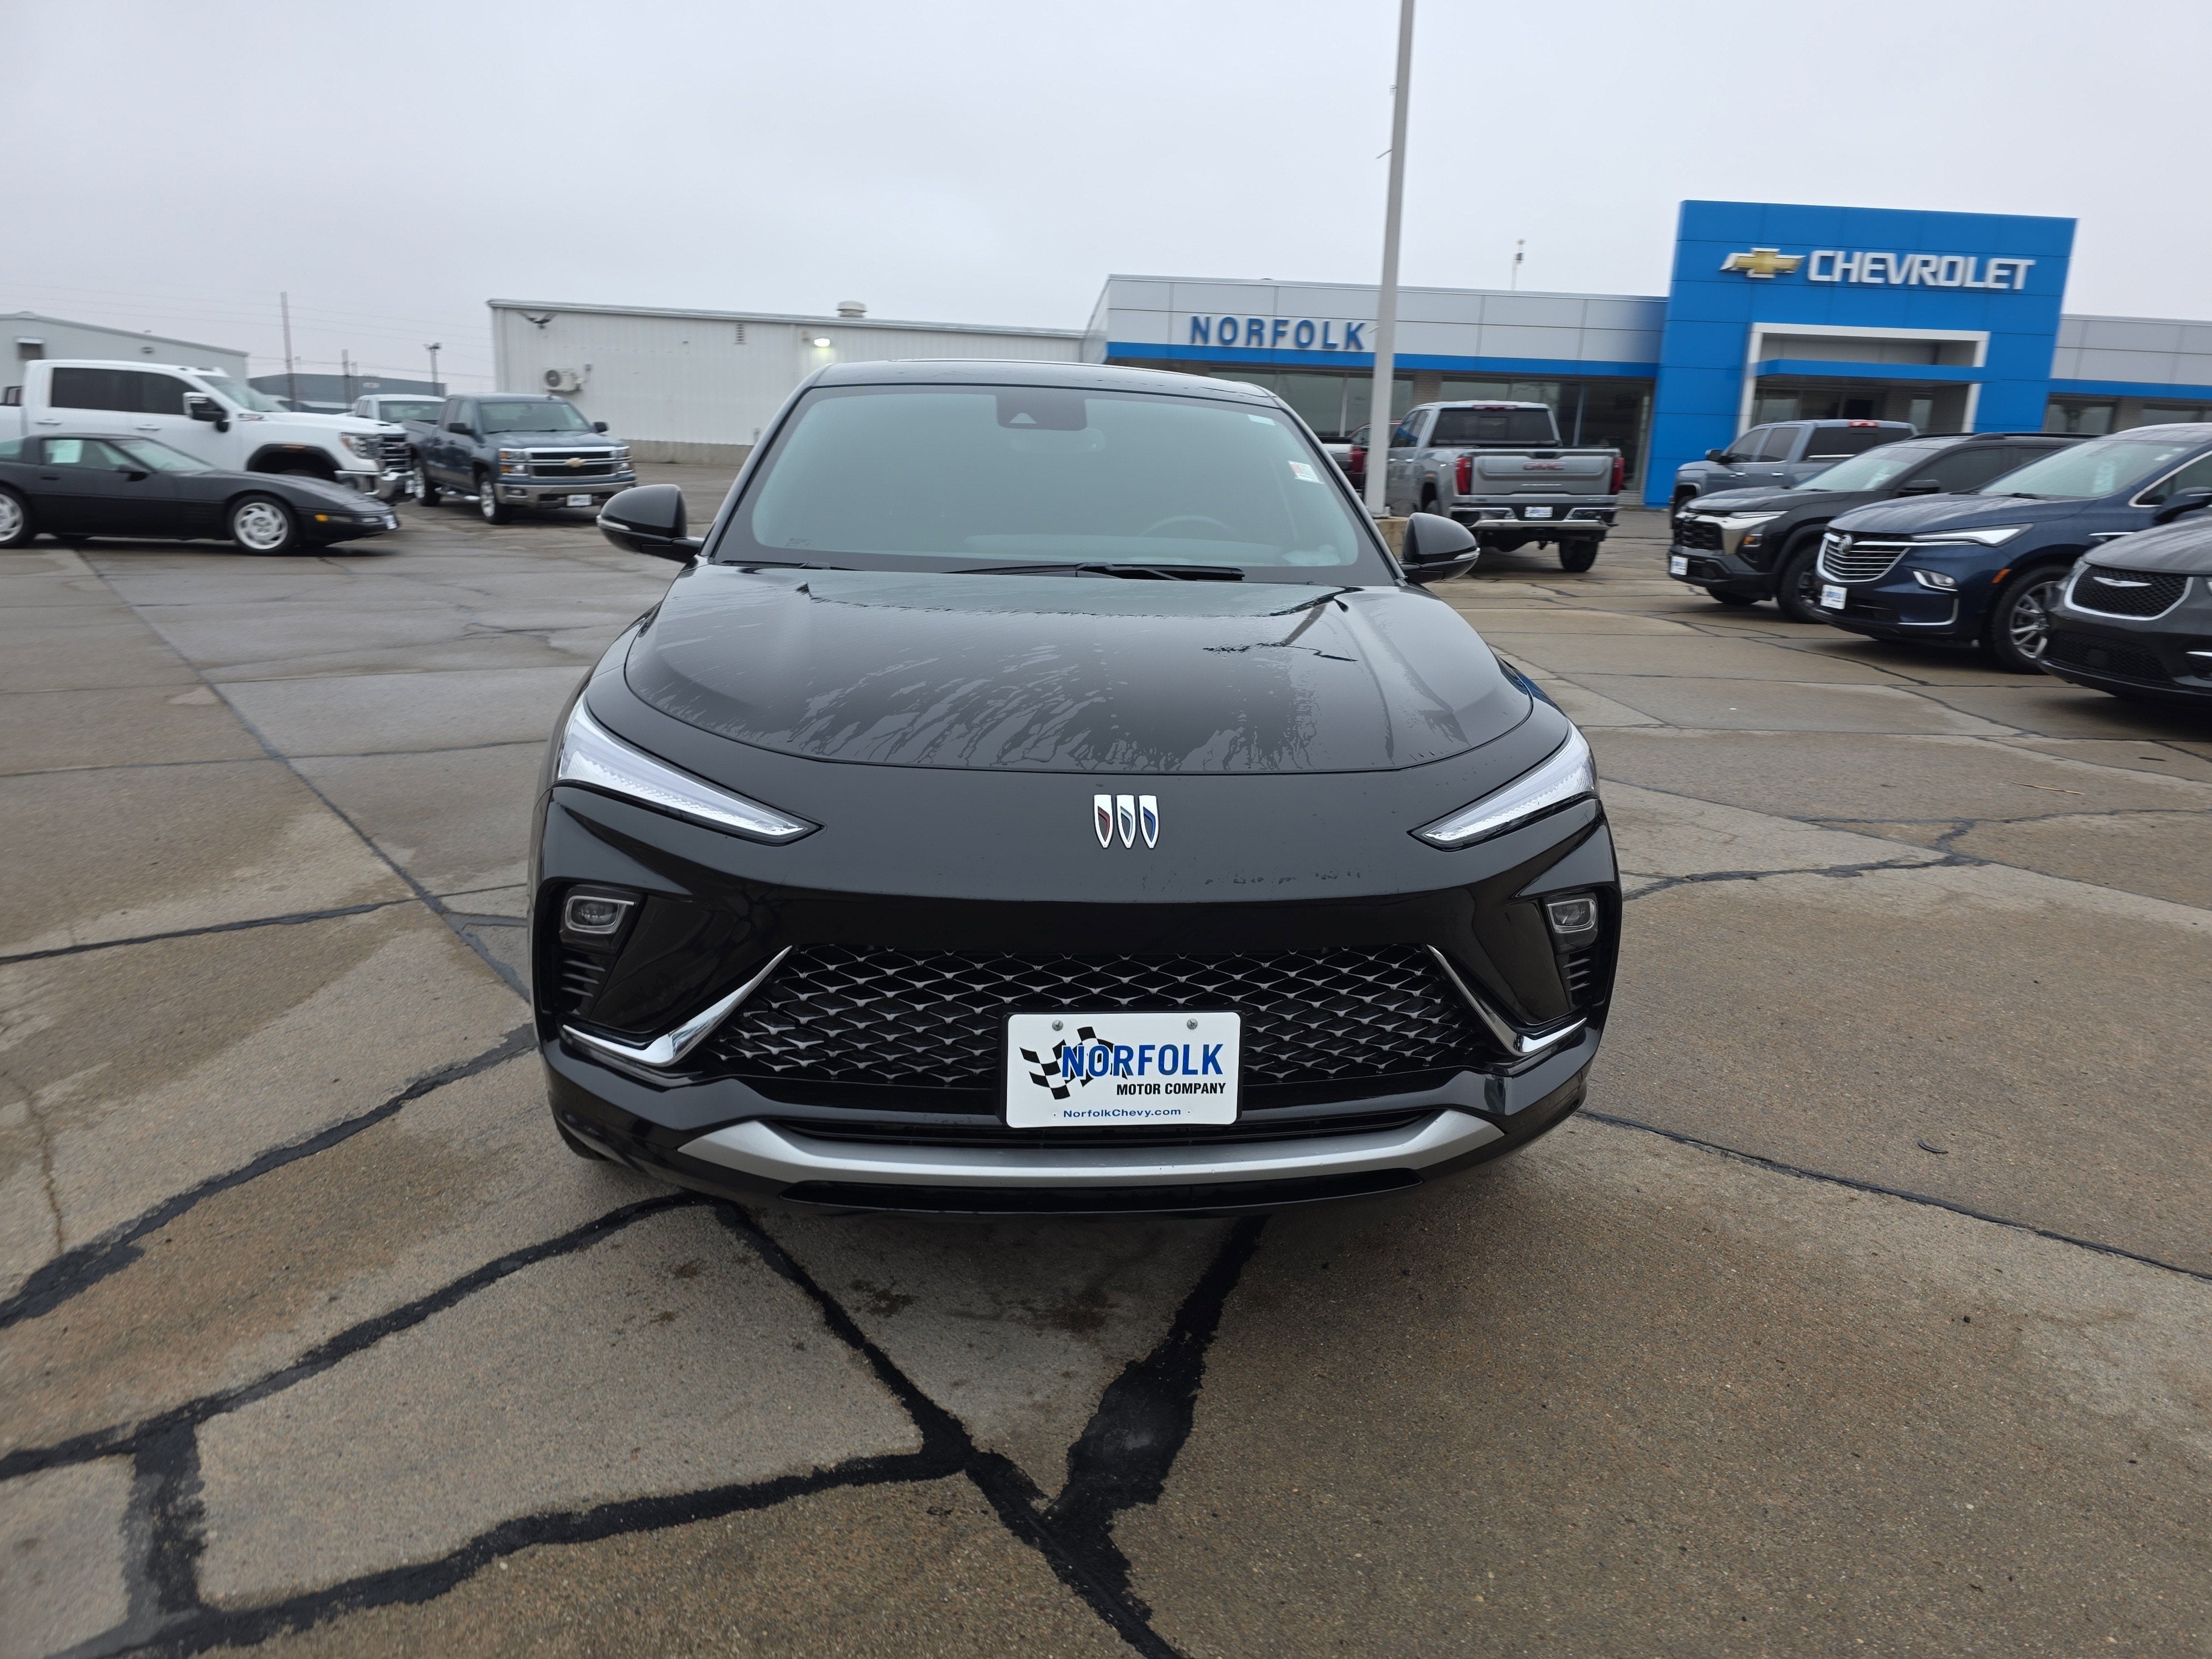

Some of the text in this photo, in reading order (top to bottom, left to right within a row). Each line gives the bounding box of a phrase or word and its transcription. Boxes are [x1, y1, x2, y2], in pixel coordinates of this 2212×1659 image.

[1808, 250, 2036, 290] CHEVROLET
[1190, 316, 1367, 350] NORFOLK
[1062, 1044, 1224, 1078] NORFOLK
[1116, 1082, 1226, 1095] MOTOR COMPANY
[1063, 1109, 1181, 1118] NorfolkChevy.com
